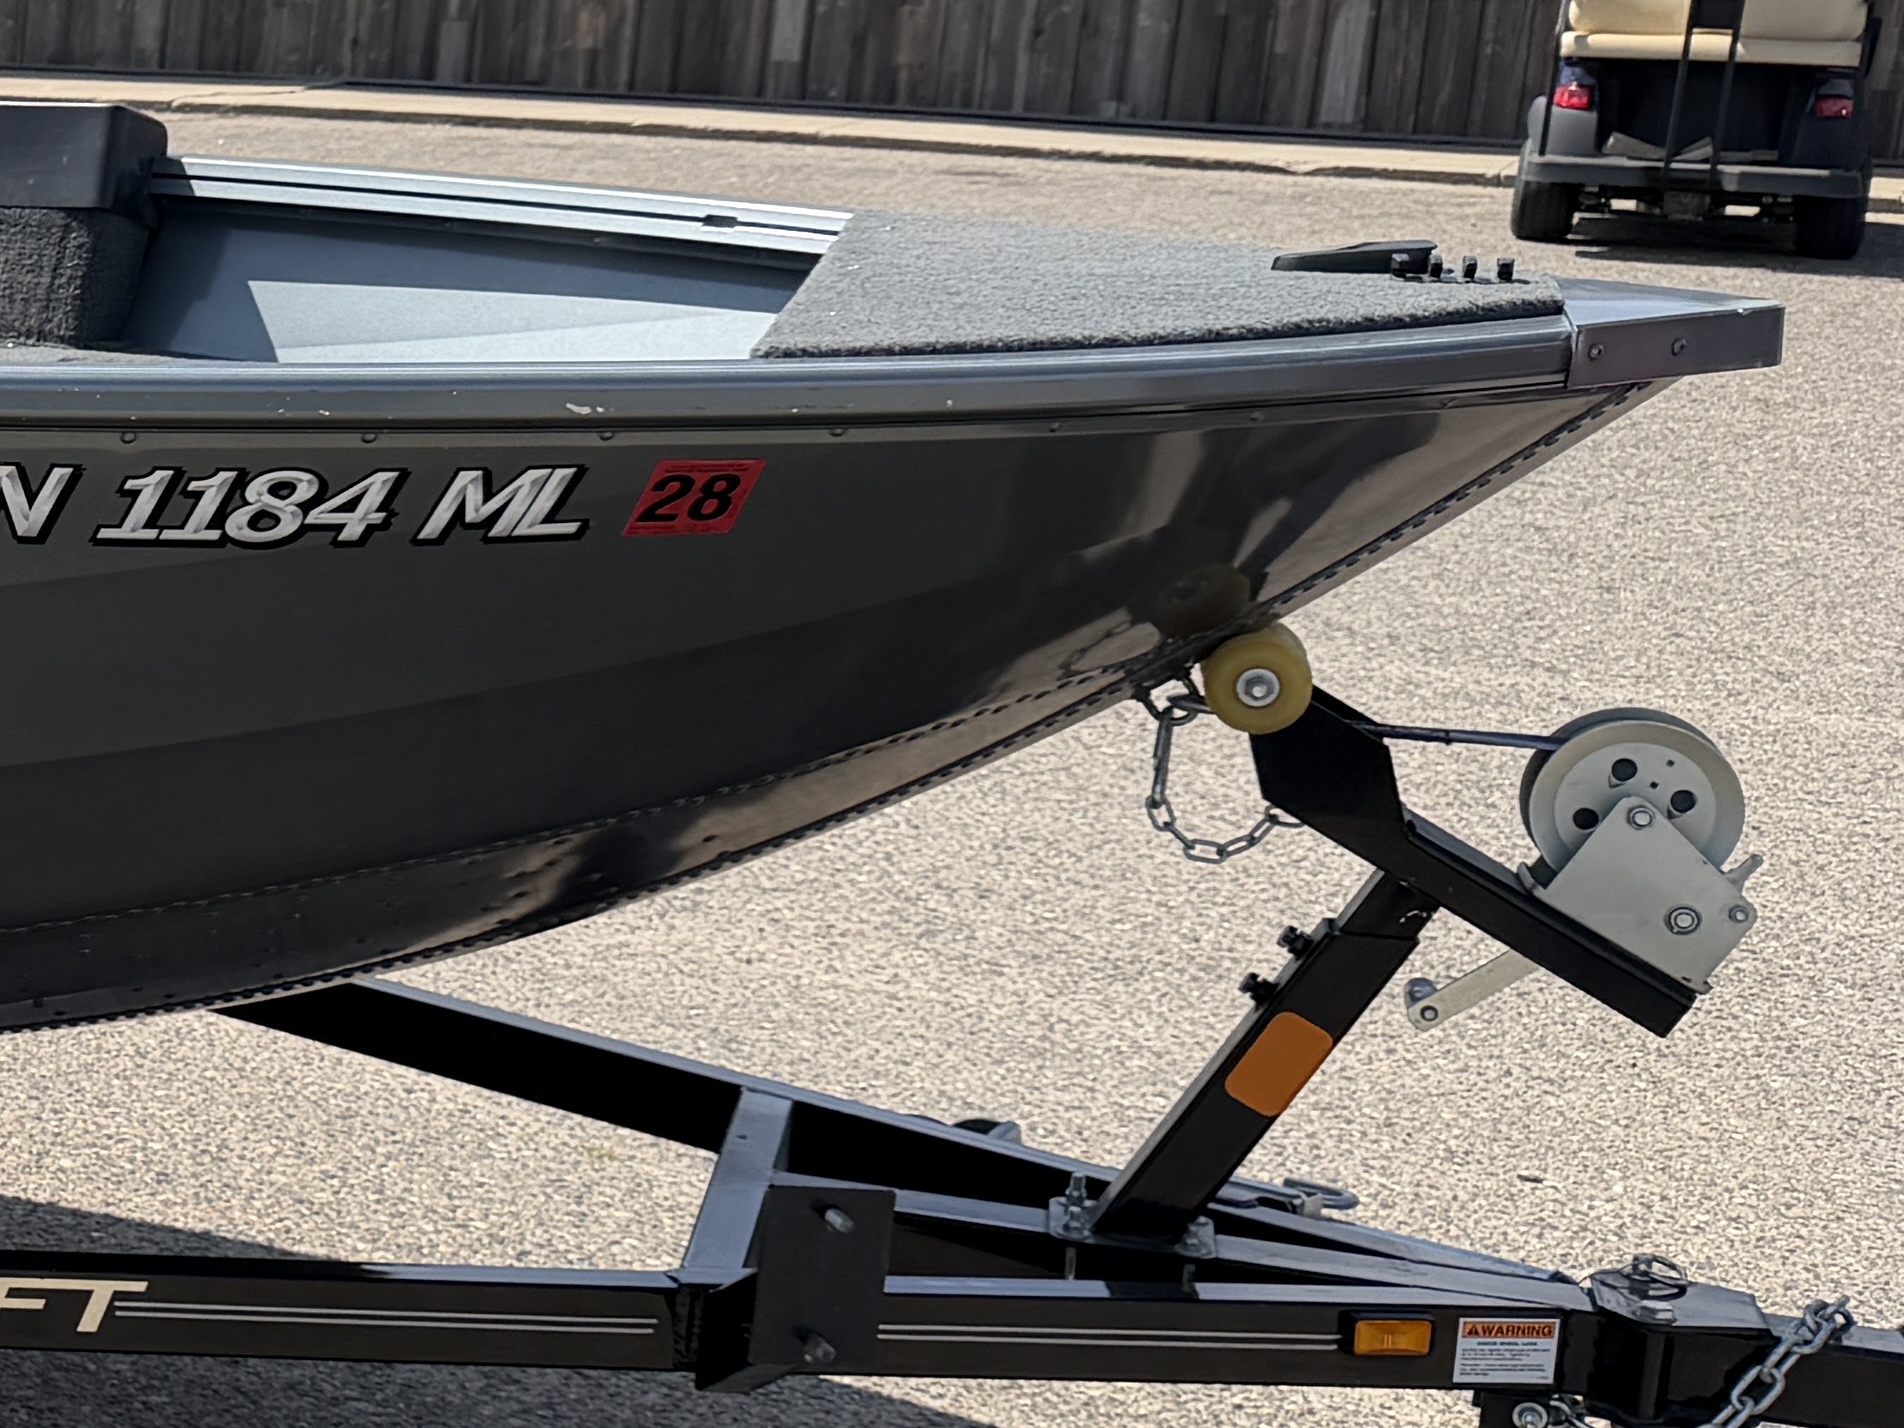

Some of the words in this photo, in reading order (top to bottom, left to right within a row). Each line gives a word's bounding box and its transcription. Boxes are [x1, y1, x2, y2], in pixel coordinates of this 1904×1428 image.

[93, 465, 405, 547] 1184
[412, 465, 595, 544] ML
[634, 473, 742, 523] 28
[1480, 1324, 1553, 1337] WARNING
